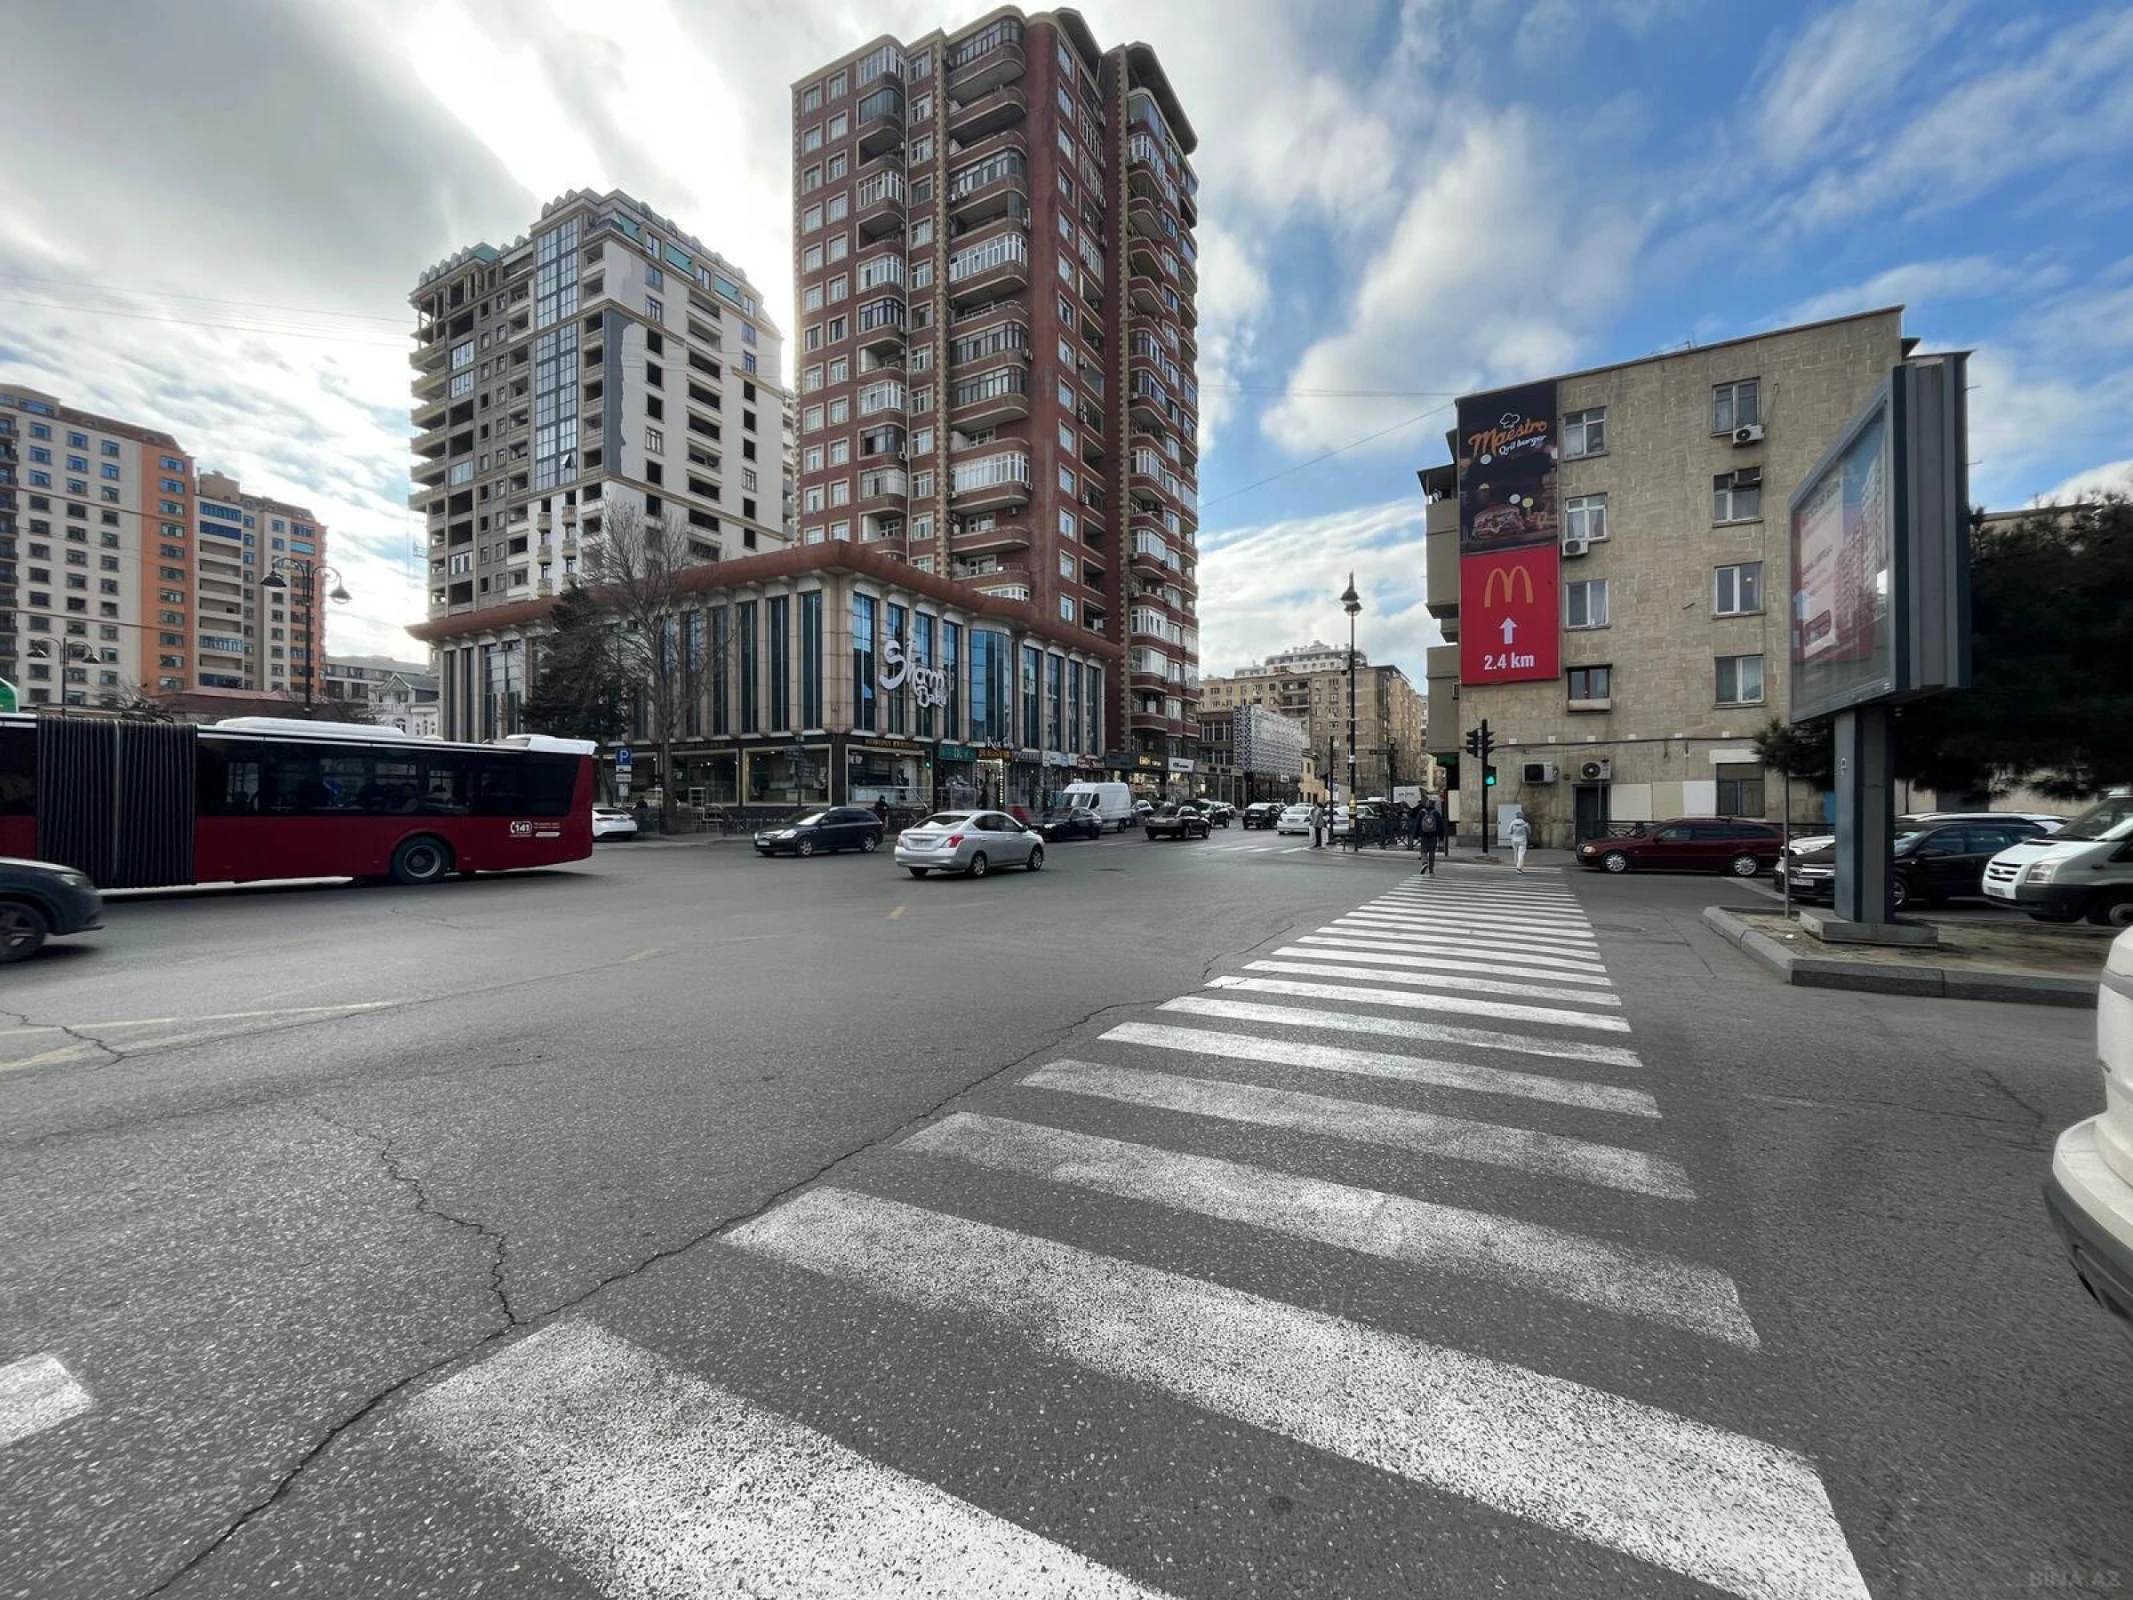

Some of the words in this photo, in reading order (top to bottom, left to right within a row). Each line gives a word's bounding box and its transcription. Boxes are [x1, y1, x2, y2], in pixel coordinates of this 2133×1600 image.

[1468, 418, 1547, 457] Maestro
[879, 632, 947, 695] Sham
[1483, 653, 1507, 670] 2.4
[1511, 652, 1535, 669] km
[619, 750, 629, 762] P
[515, 824, 530, 833] 141
